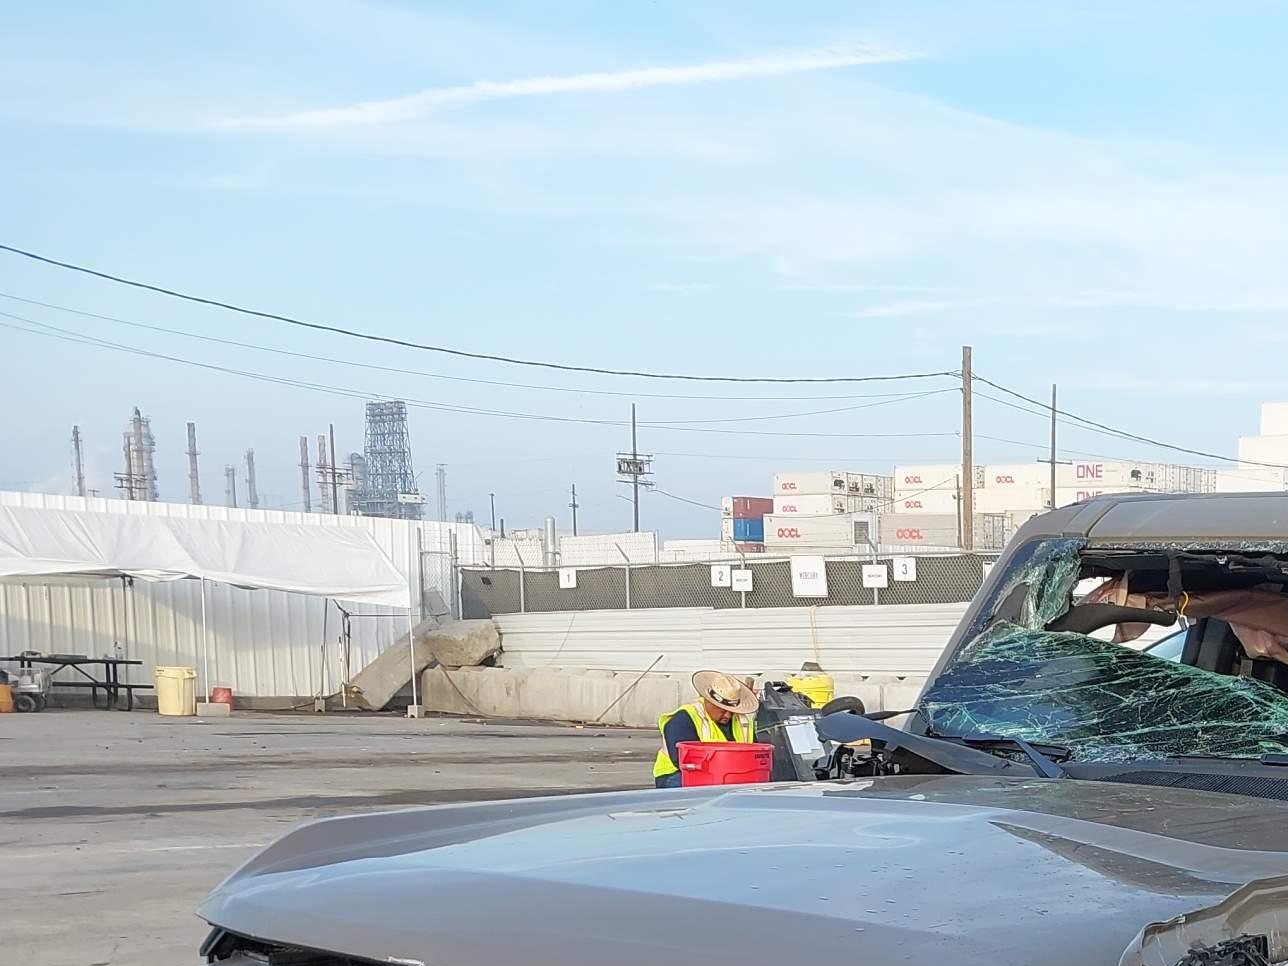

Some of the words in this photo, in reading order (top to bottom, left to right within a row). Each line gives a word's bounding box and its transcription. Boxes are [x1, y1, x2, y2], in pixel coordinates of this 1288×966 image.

[1076, 463, 1103, 479] ONE
[904, 475, 924, 485] OOCL
[995, 475, 1015, 484] OOCL
[782, 482, 797, 491] OOCL
[782, 505, 798, 513] OOCL
[904, 500, 924, 509] OOCL
[777, 527, 801, 539] OOCL
[896, 528, 924, 540] OOCL
[902, 563, 908, 575] 3
[718, 570, 724, 582] 2
